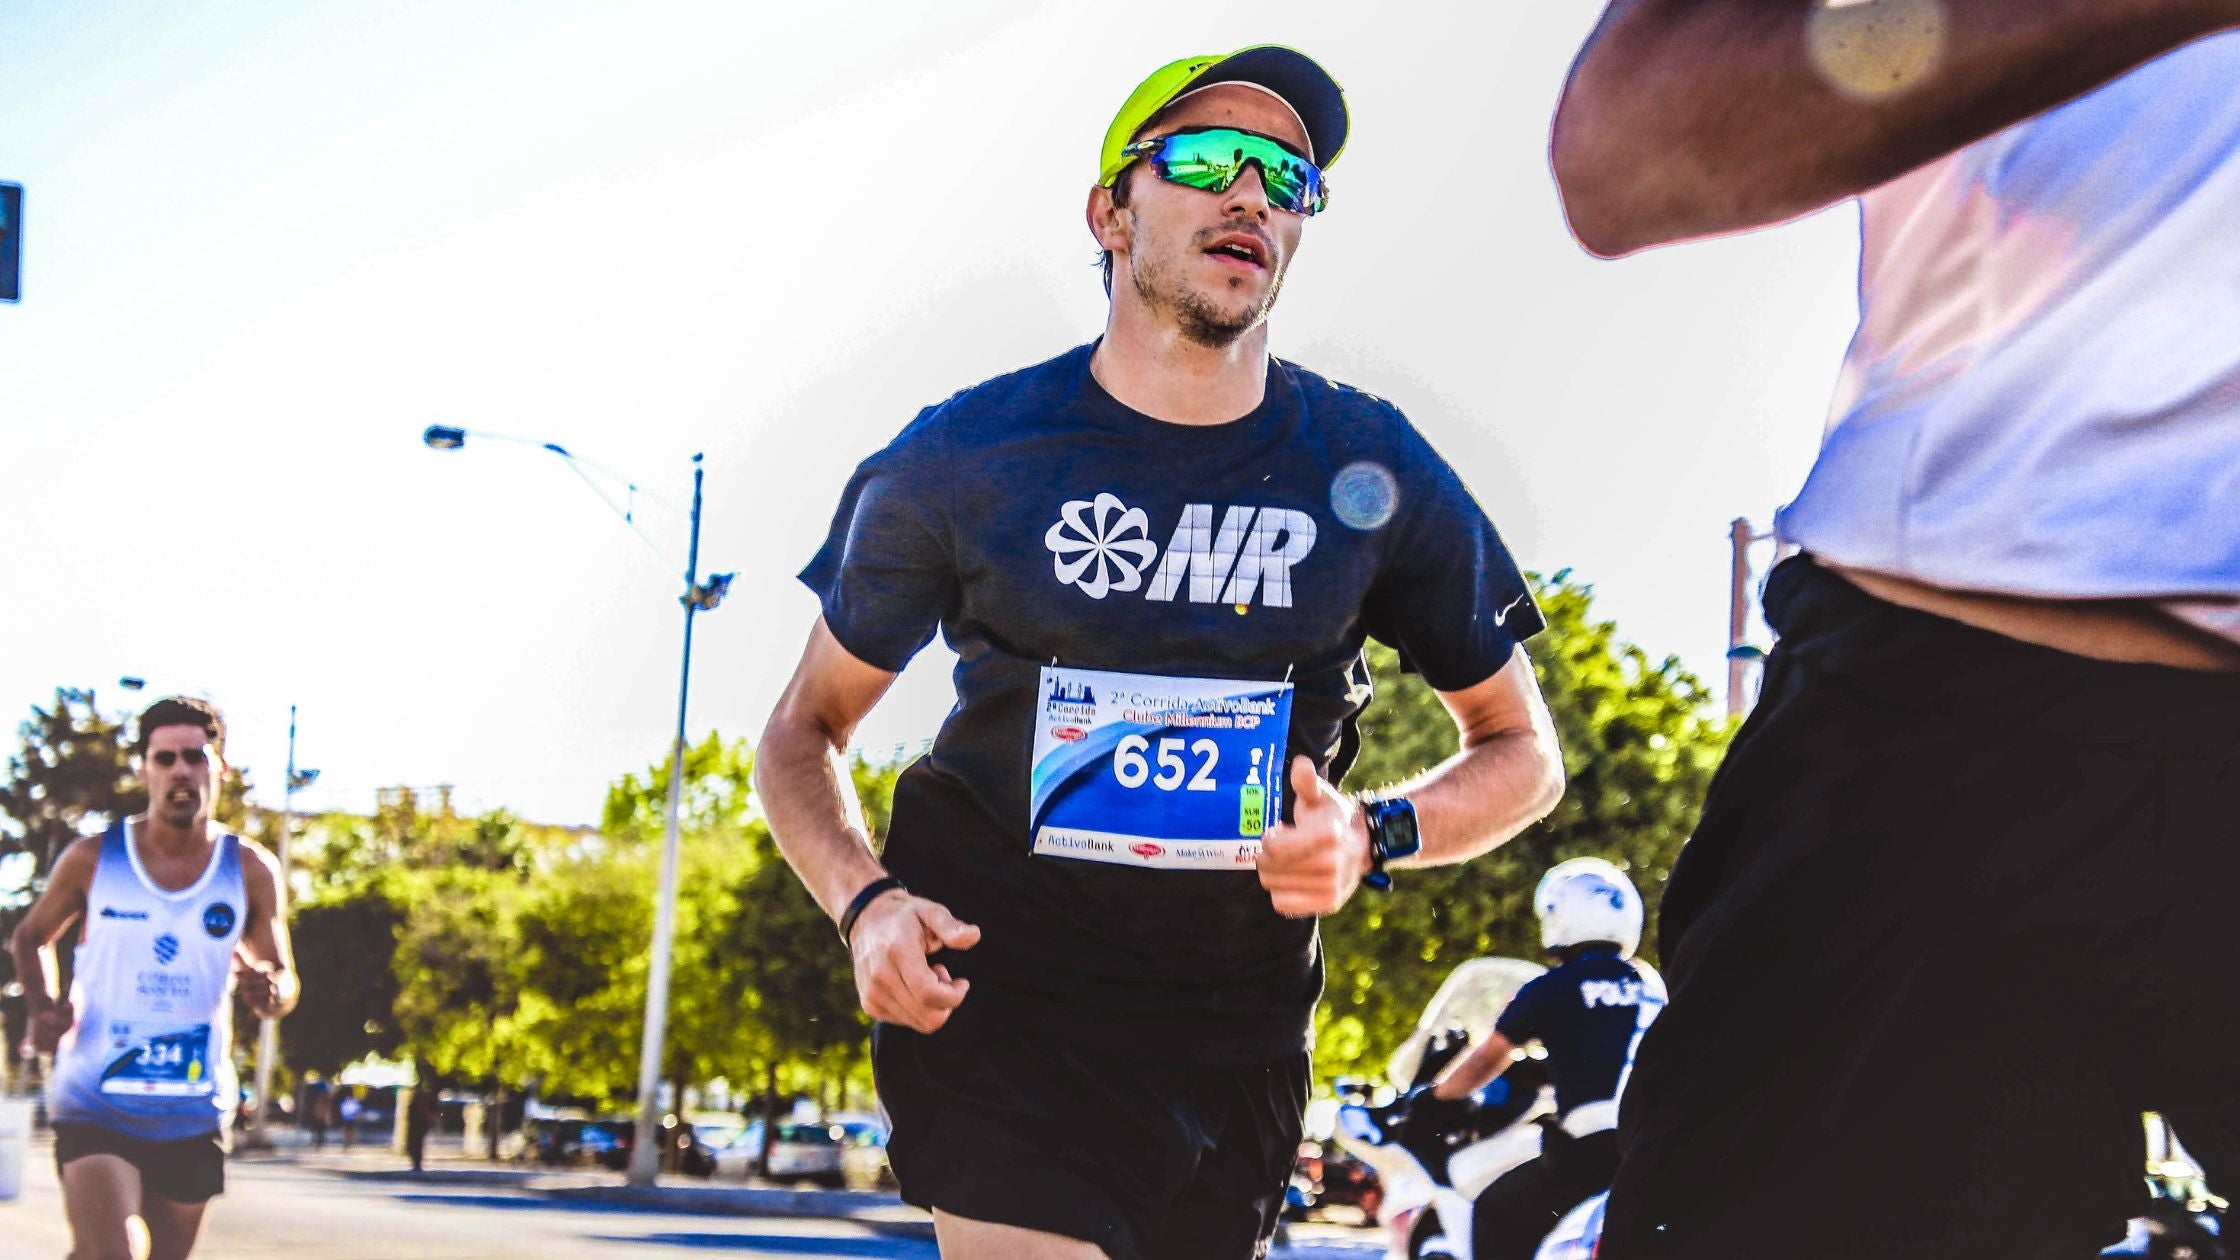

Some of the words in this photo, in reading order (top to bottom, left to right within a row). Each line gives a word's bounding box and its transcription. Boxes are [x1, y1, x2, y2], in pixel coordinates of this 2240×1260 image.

[1130, 692, 1188, 709] Corrida
[1191, 697, 1276, 716] ActivoBank
[1122, 708, 1162, 724] Clube
[1165, 712, 1233, 730] Millennium
[1234, 714, 1261, 730] BCP
[1113, 734, 1220, 792] 652
[1047, 835, 1115, 854] ActivoBank
[135, 1042, 184, 1067] 334
